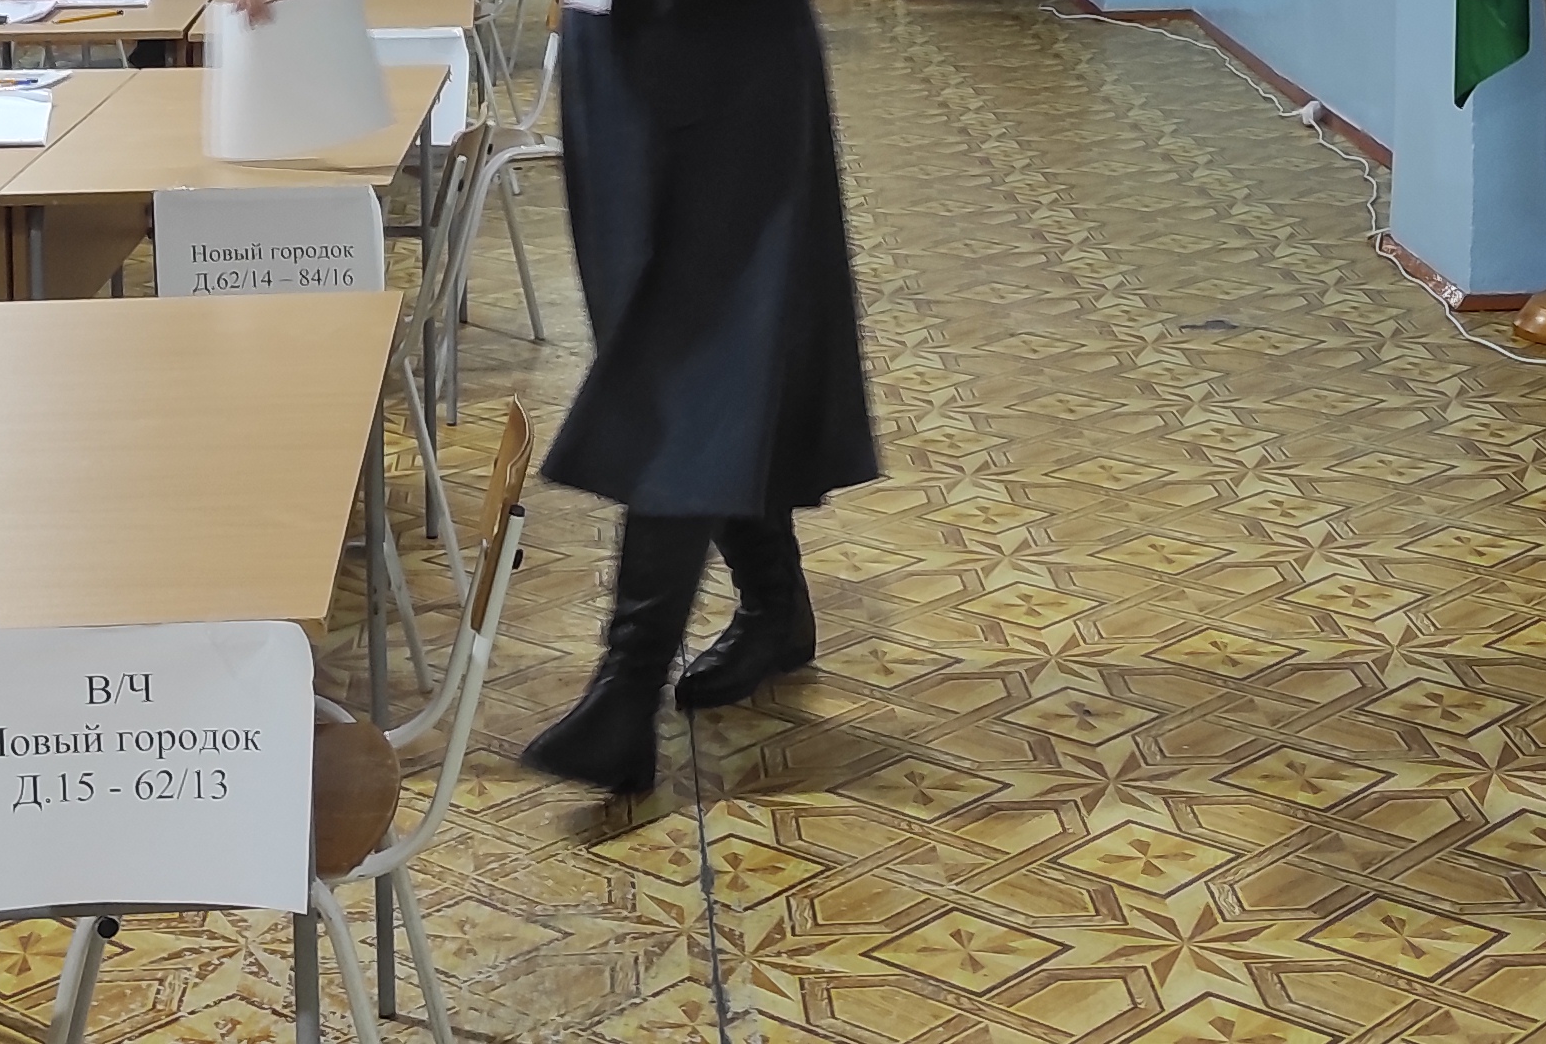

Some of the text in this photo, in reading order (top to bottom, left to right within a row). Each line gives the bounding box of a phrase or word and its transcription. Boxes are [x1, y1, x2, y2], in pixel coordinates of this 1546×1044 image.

[190, 242, 355, 265] Новый городок
[192, 270, 273, 295] Д.62/14
[299, 268, 354, 288] 84/16
[84, 673, 153, 705] В/Ч
[116, 728, 262, 760] городок
[12, 772, 96, 814] Д.15
[134, 768, 229, 802] 62/13
